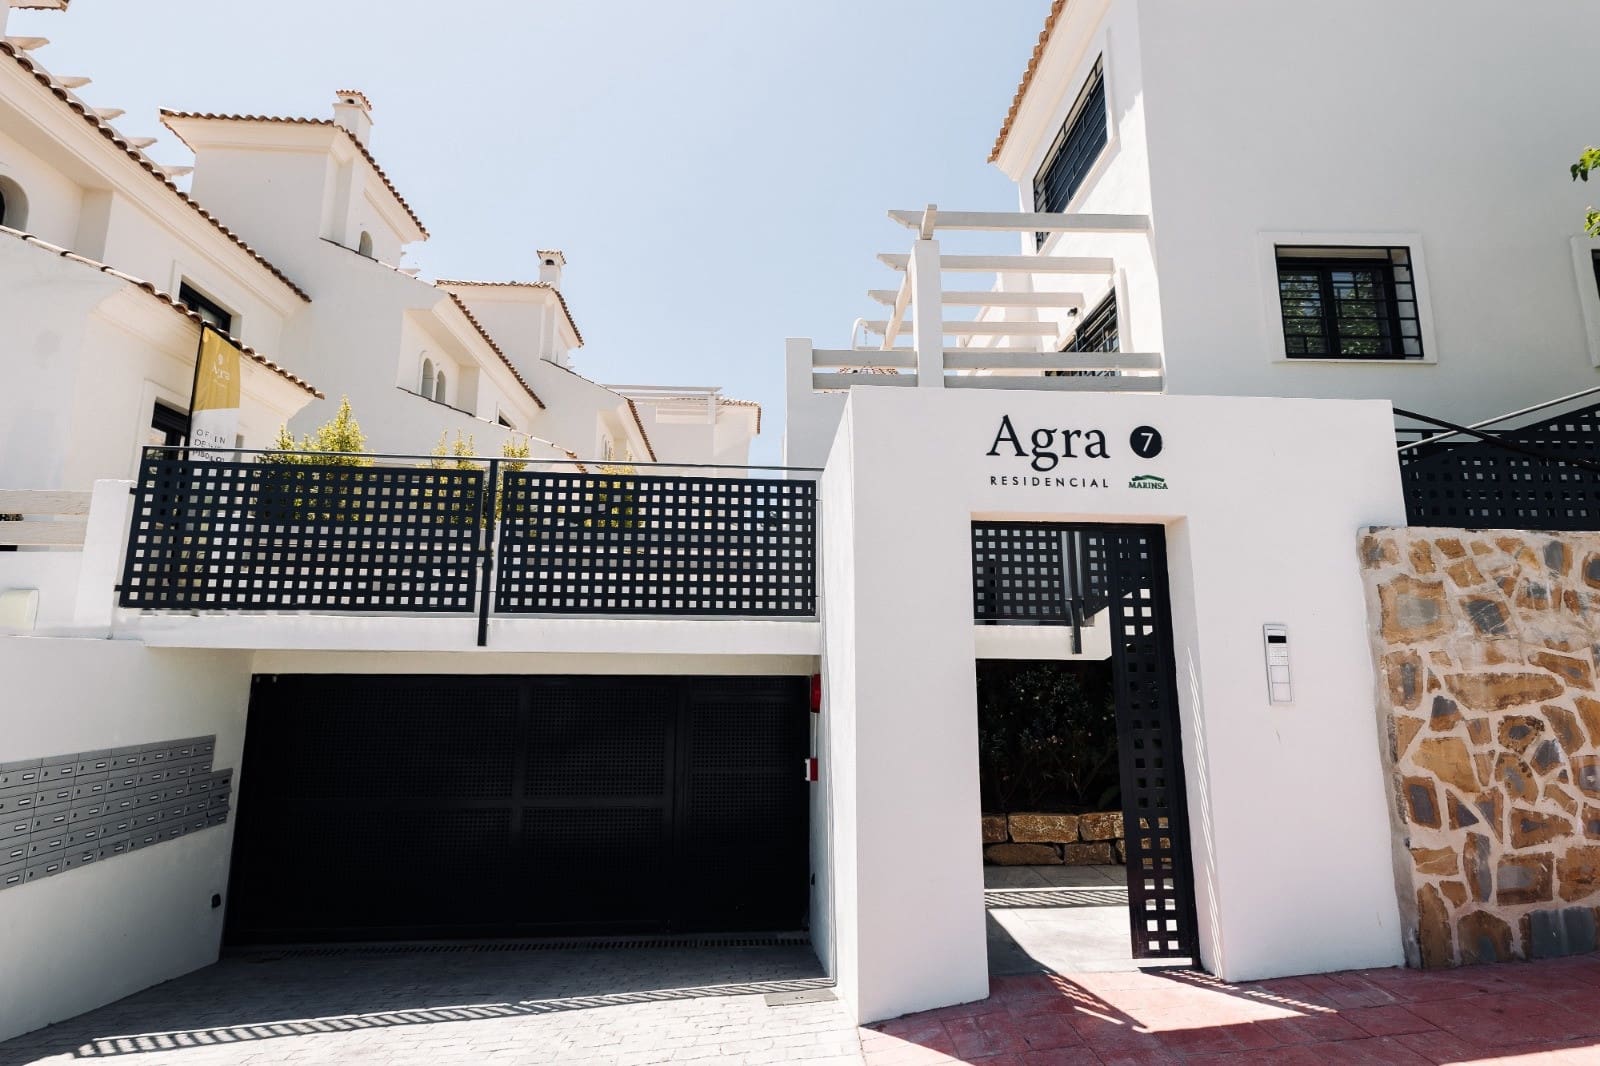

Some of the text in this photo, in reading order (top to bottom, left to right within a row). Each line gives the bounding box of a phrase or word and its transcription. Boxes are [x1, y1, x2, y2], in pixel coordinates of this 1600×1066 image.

[986, 414, 1154, 472] Agra 7
[990, 476, 1169, 490] RESIDENCIAL MARINSA
